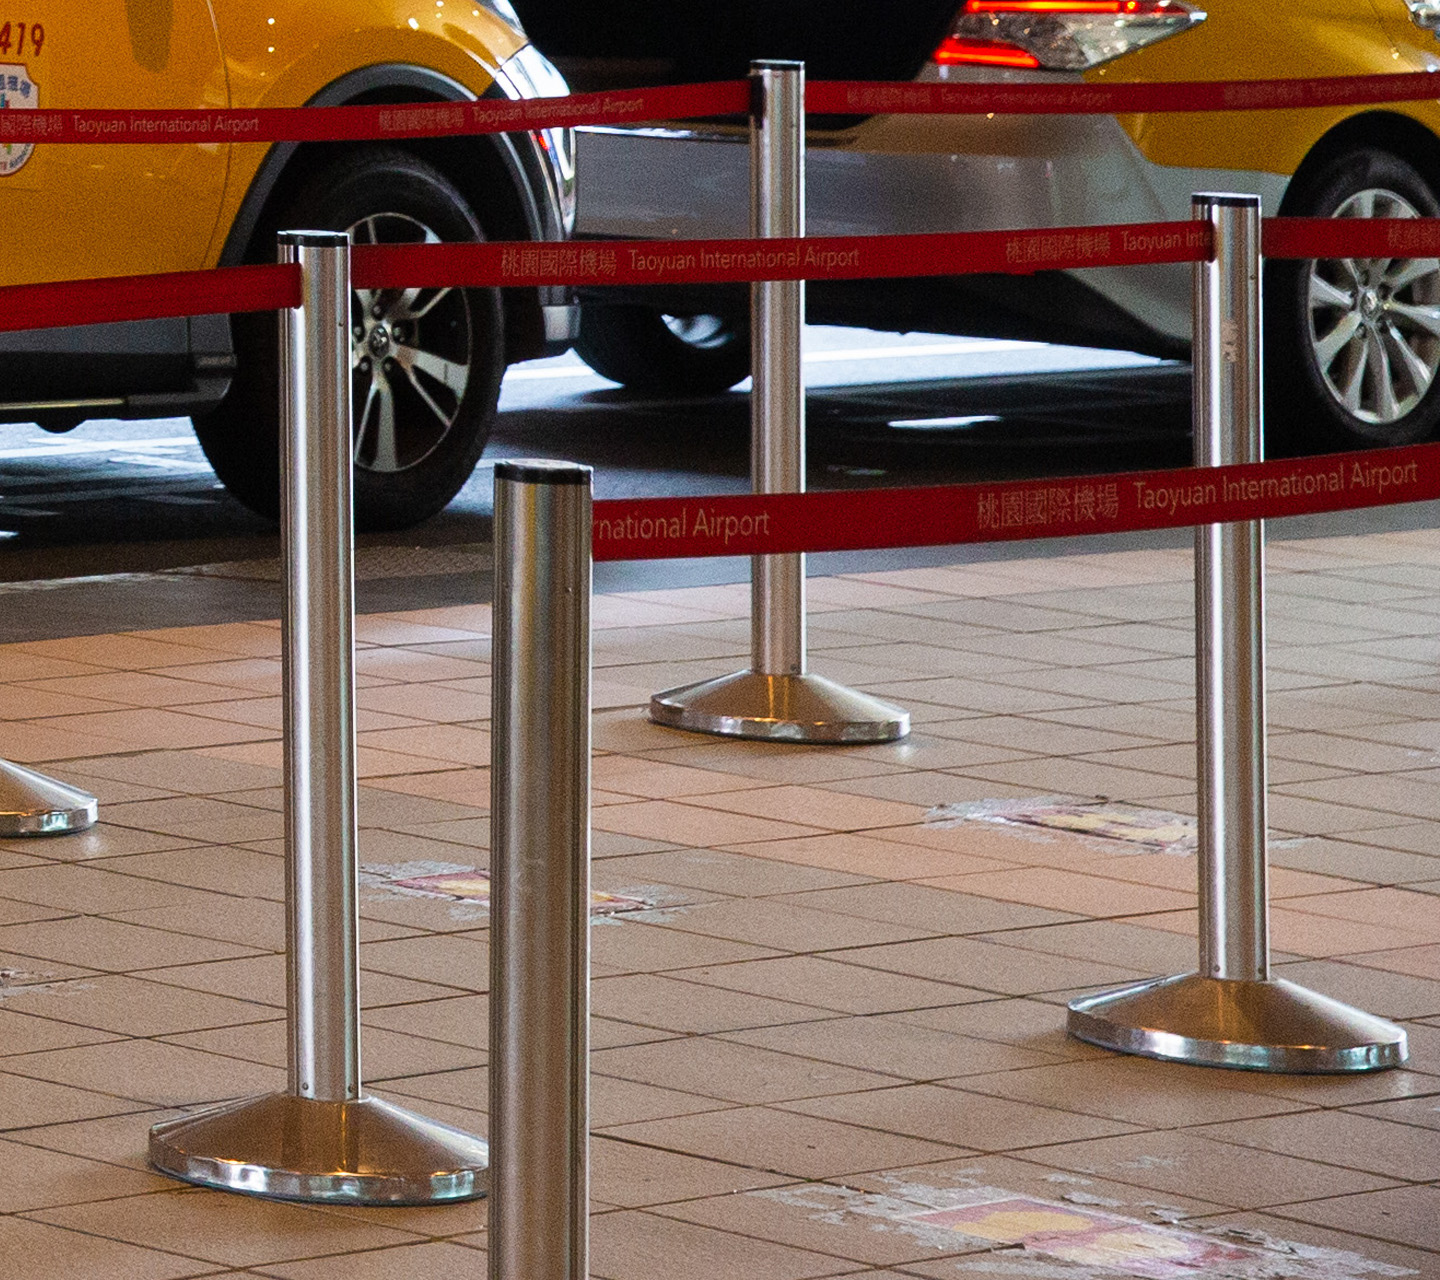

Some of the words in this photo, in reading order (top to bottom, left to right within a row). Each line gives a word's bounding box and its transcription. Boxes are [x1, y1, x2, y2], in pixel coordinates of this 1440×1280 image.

[72, 115, 127, 139] Taoyuan
[129, 114, 212, 134] International
[213, 115, 260, 135] Airport
[1121, 229, 1181, 255] Taoyuan
[627, 248, 697, 277] Taoyuan
[699, 245, 800, 269] International
[802, 244, 861, 269] Airport
[1131, 480, 1218, 516] Taoyuan
[1221, 461, 1345, 503] International
[1349, 458, 1419, 496] Airport
[692, 507, 772, 546] Airport
